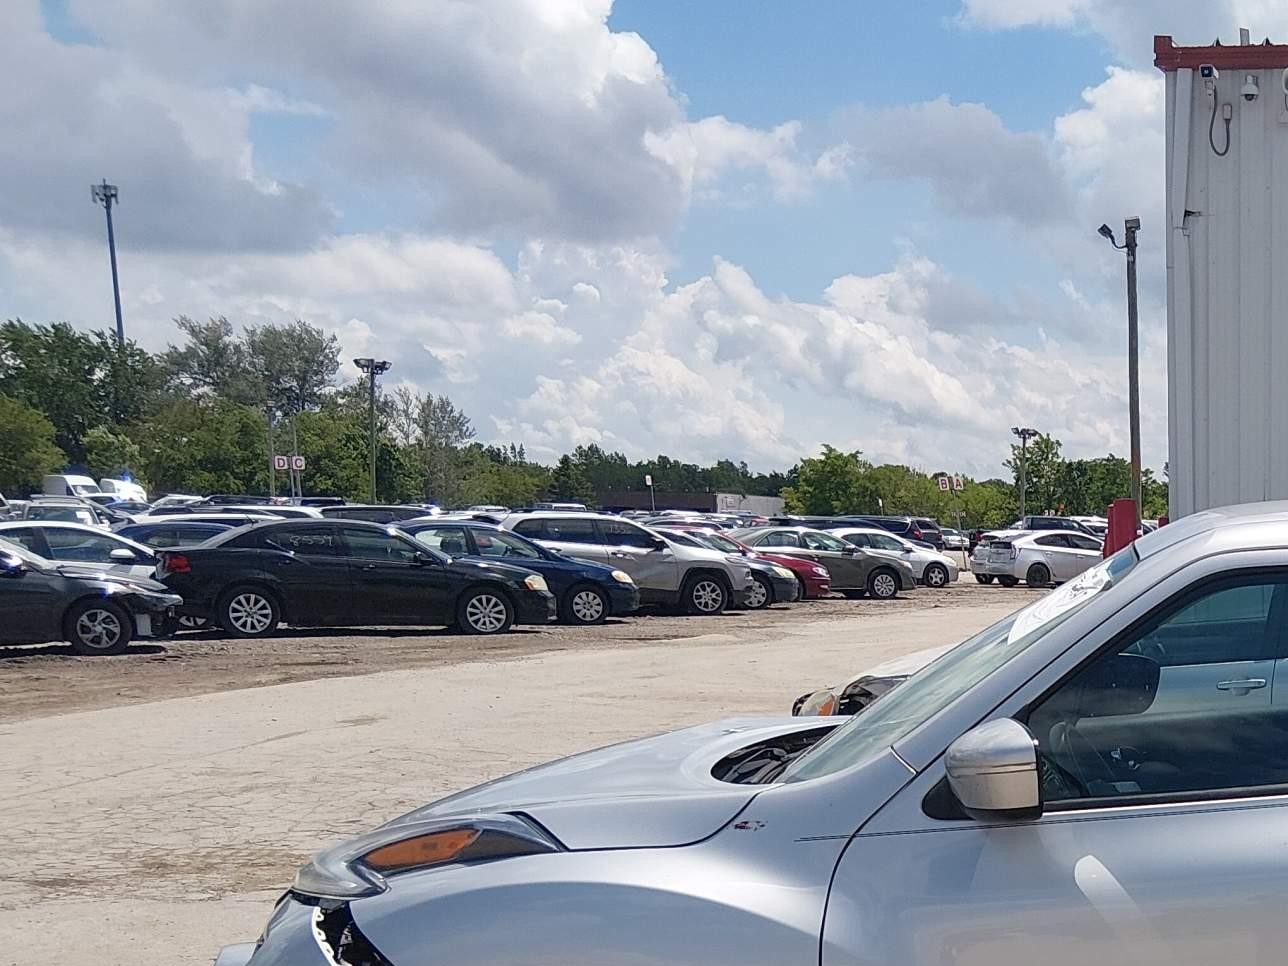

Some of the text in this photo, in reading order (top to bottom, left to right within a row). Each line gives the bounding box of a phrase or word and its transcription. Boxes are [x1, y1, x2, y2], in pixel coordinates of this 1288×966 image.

[277, 458, 286, 468] D
[294, 458, 303, 468] C
[940, 479, 947, 489] B
[955, 478, 962, 488] A
